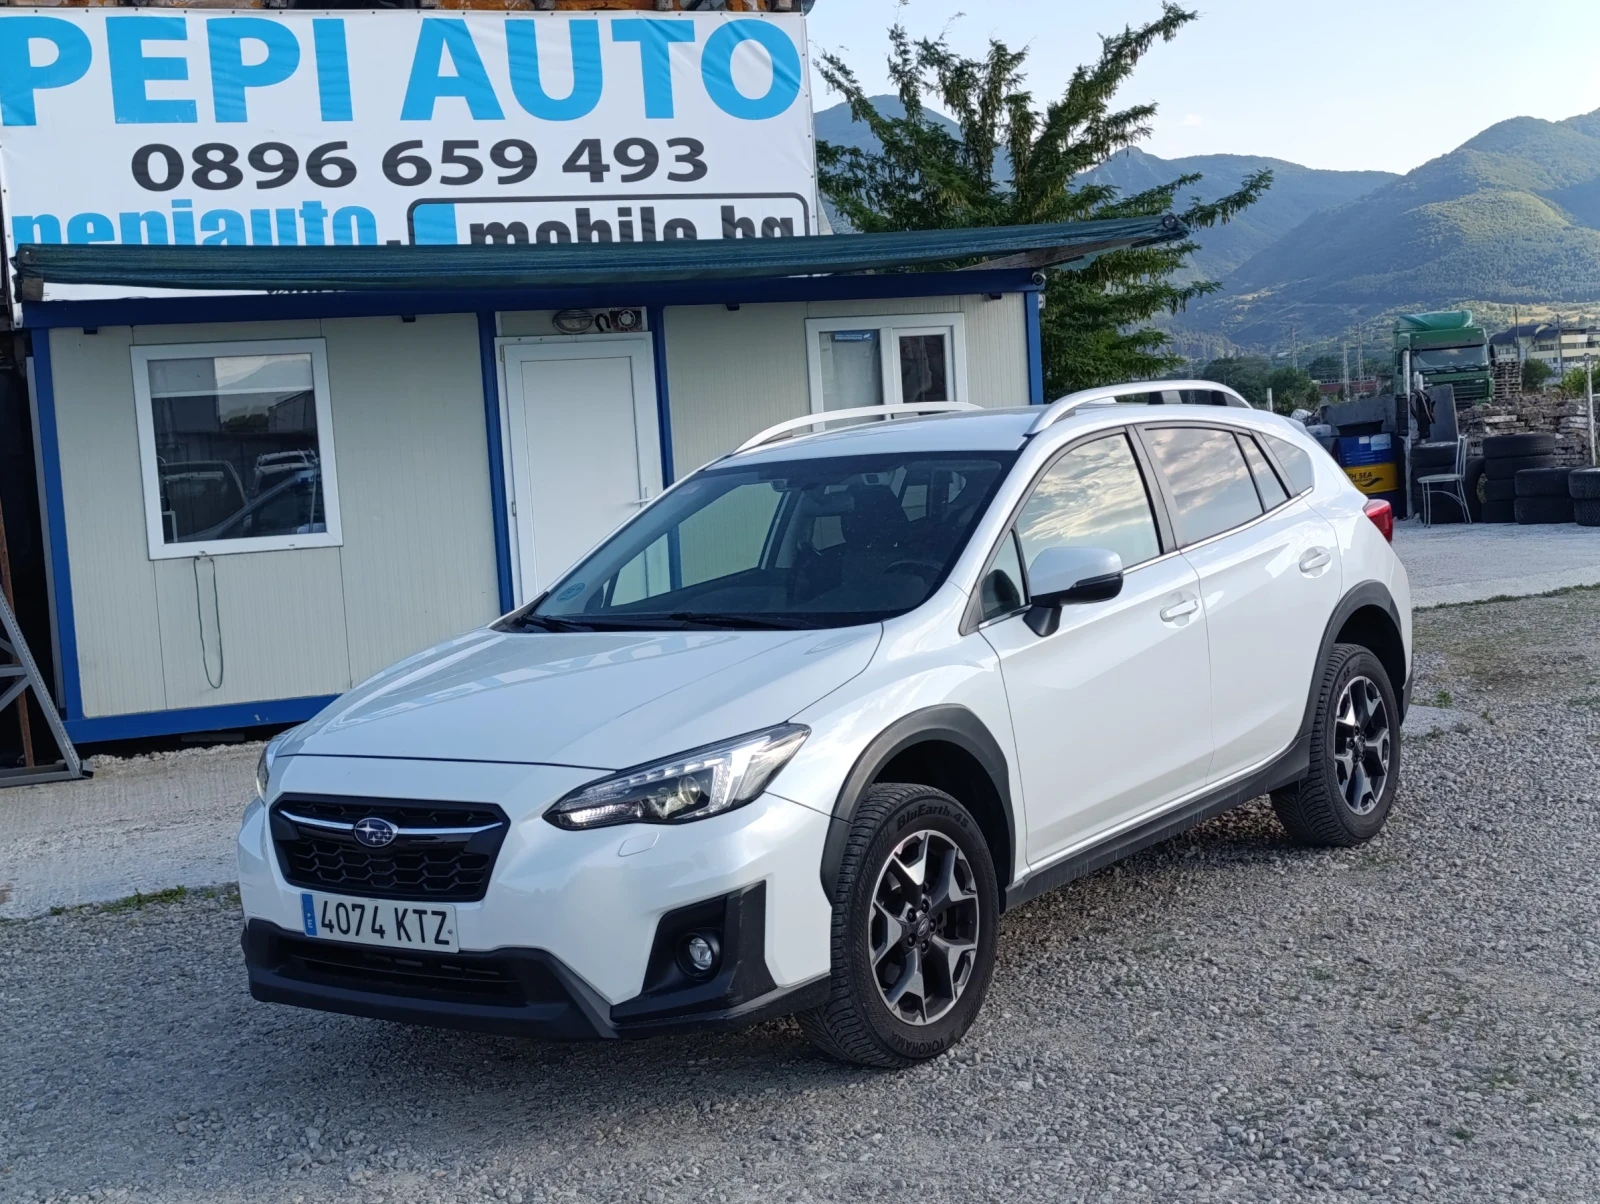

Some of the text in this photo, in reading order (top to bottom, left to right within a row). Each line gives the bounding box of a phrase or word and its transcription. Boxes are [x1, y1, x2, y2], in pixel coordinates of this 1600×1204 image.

[0, 16, 802, 126] PEPI AUTO
[131, 137, 708, 192] 0896 659 493
[321, 900, 450, 946] 4074 KTZ
